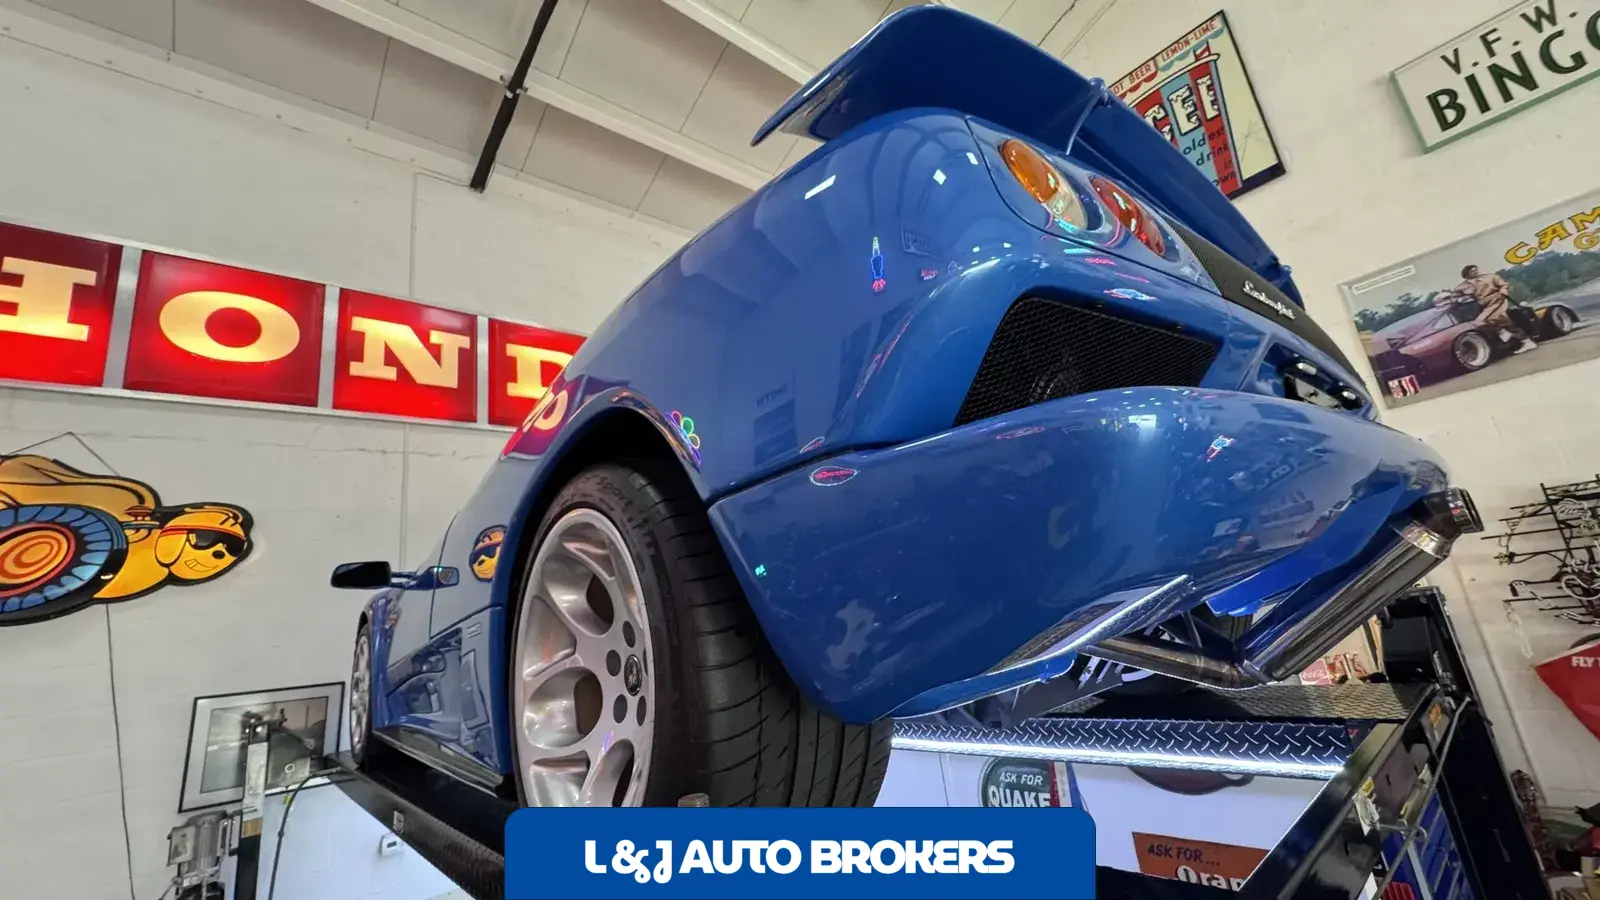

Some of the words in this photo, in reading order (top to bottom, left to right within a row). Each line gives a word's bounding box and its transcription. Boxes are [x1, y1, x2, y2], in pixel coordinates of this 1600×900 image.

[1129, 64, 1152, 84] BEER
[1161, 19, 1217, 61] LEMON-LIME
[1571, 656, 1595, 667] FLY
[999, 771, 1017, 783] ASK
[1021, 774, 1043, 786] FOR
[1147, 843, 1173, 859] ASK
